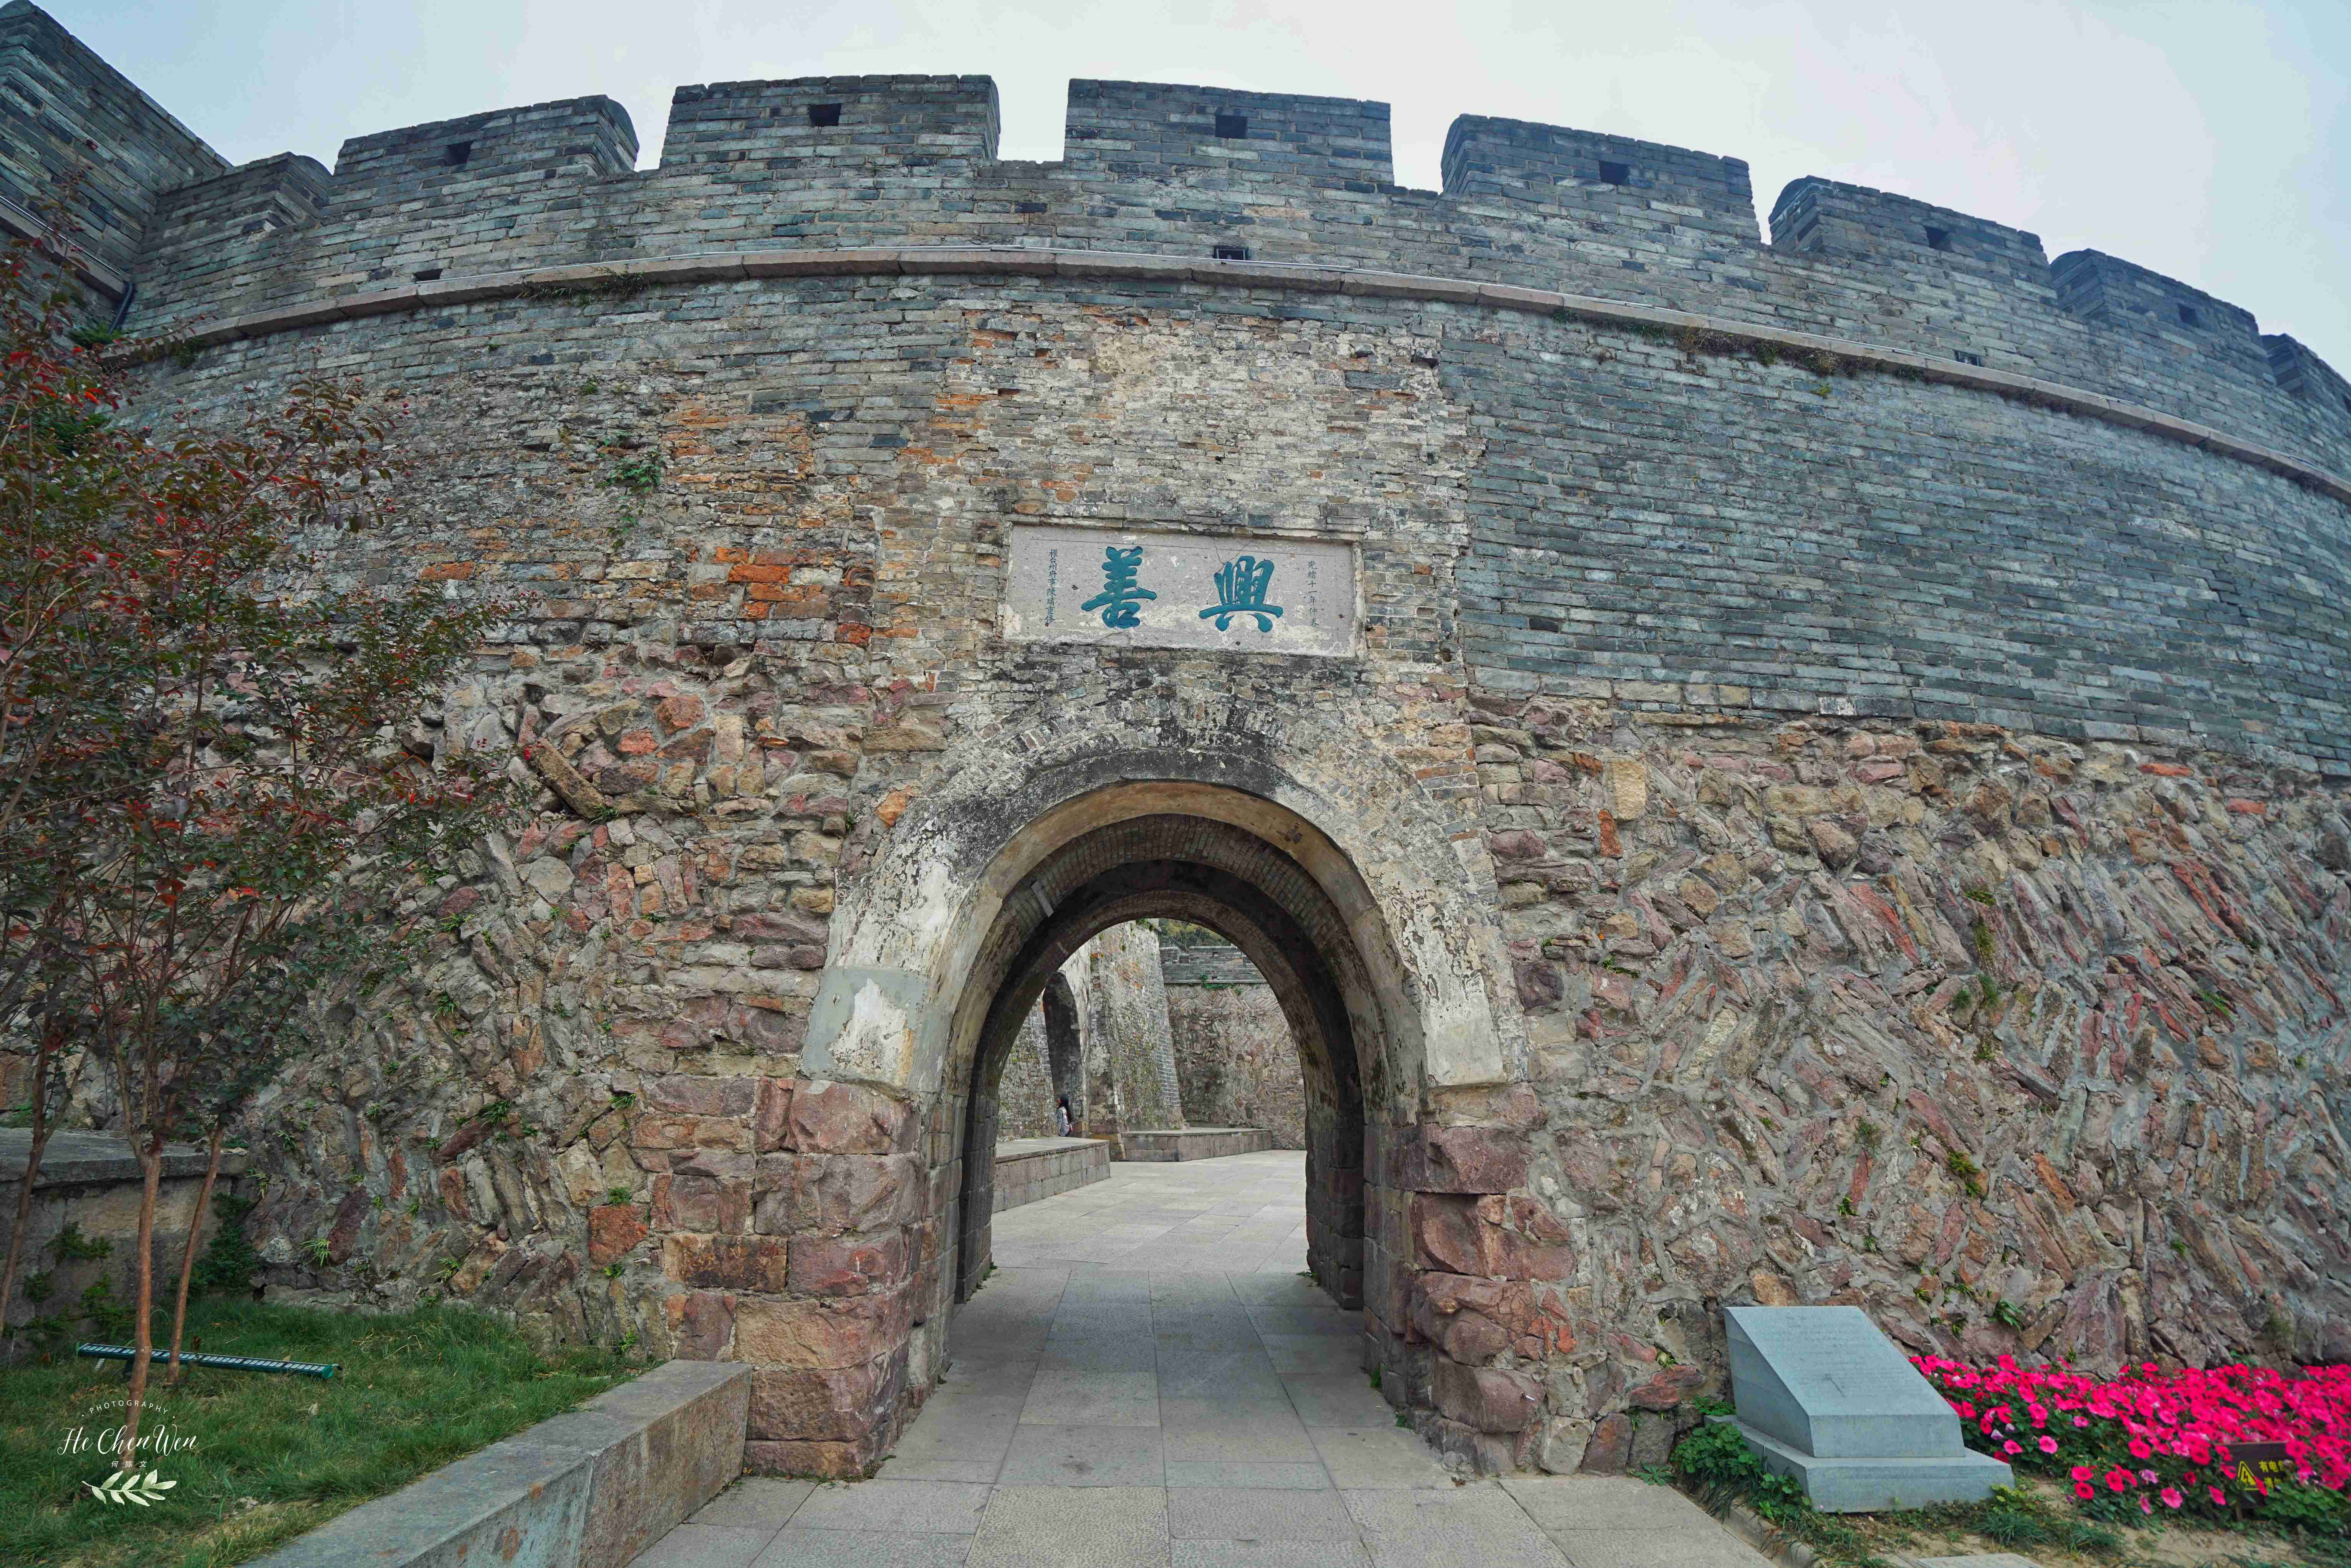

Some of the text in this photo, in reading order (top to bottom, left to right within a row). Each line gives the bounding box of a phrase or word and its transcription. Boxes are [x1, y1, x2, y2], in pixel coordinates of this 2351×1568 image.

[1307, 561, 1319, 627] 光緒十一年仲春
